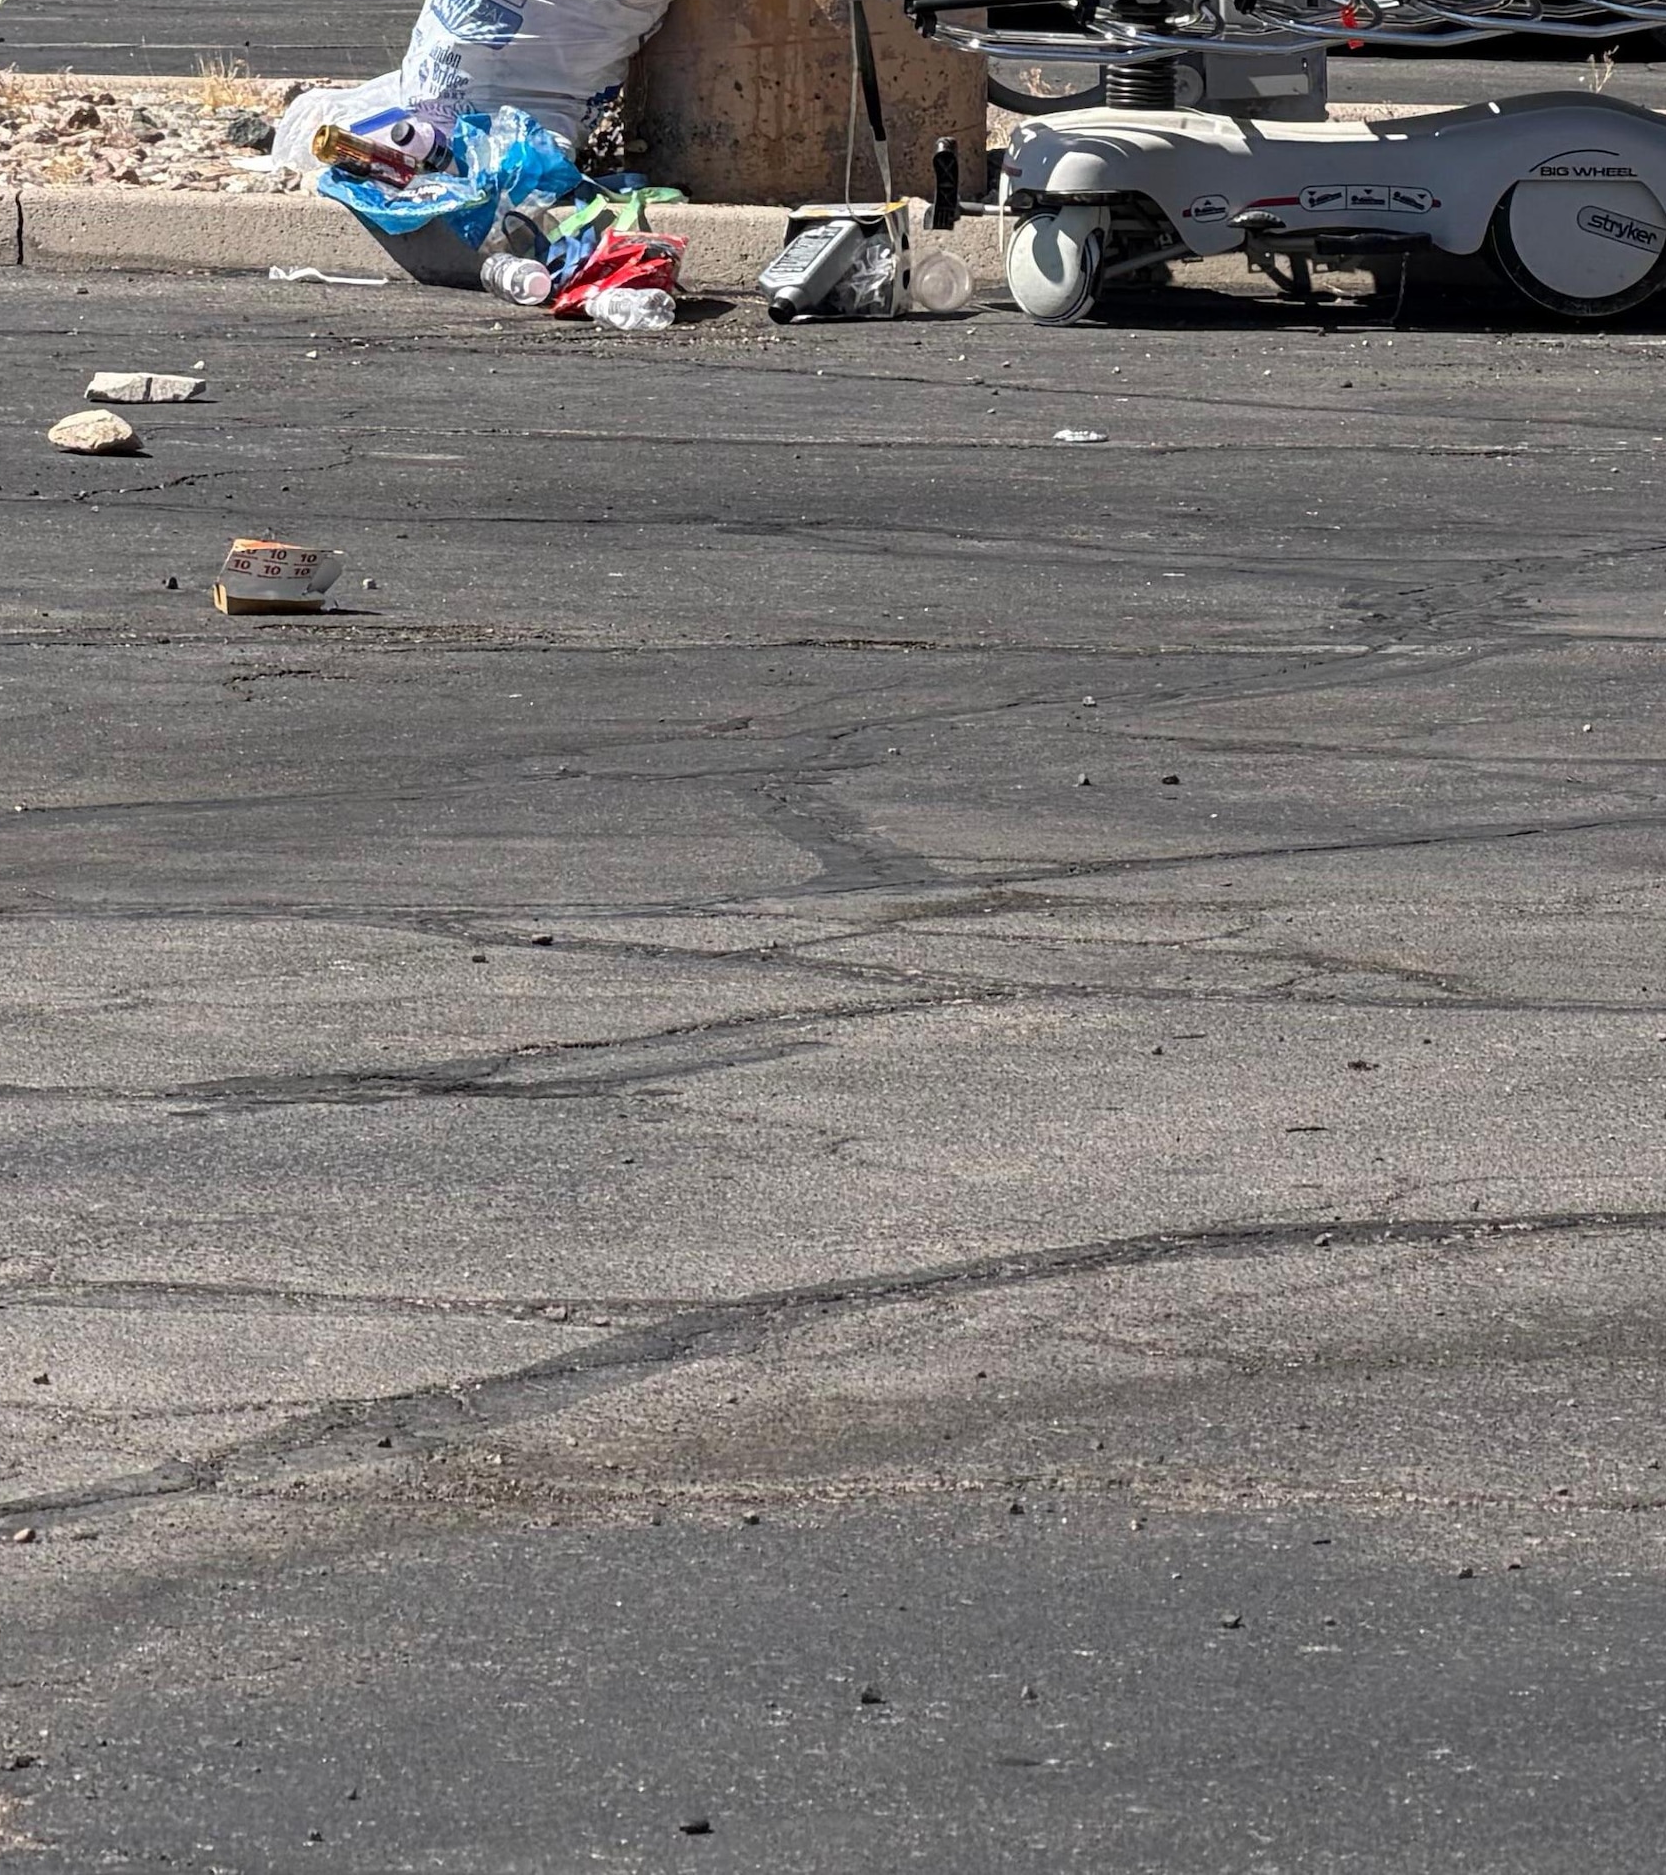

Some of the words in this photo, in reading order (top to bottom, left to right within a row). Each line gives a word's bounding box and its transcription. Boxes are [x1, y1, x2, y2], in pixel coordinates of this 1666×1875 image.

[1540, 166, 1569, 177] BIG
[1573, 167, 1638, 177] WHEEL
[1587, 214, 1657, 246] stryker
[271, 548, 287, 560] 10
[300, 553, 317, 563] 10
[234, 559, 251, 570] 10
[264, 565, 281, 575] 10
[294, 568, 310, 576] 10
